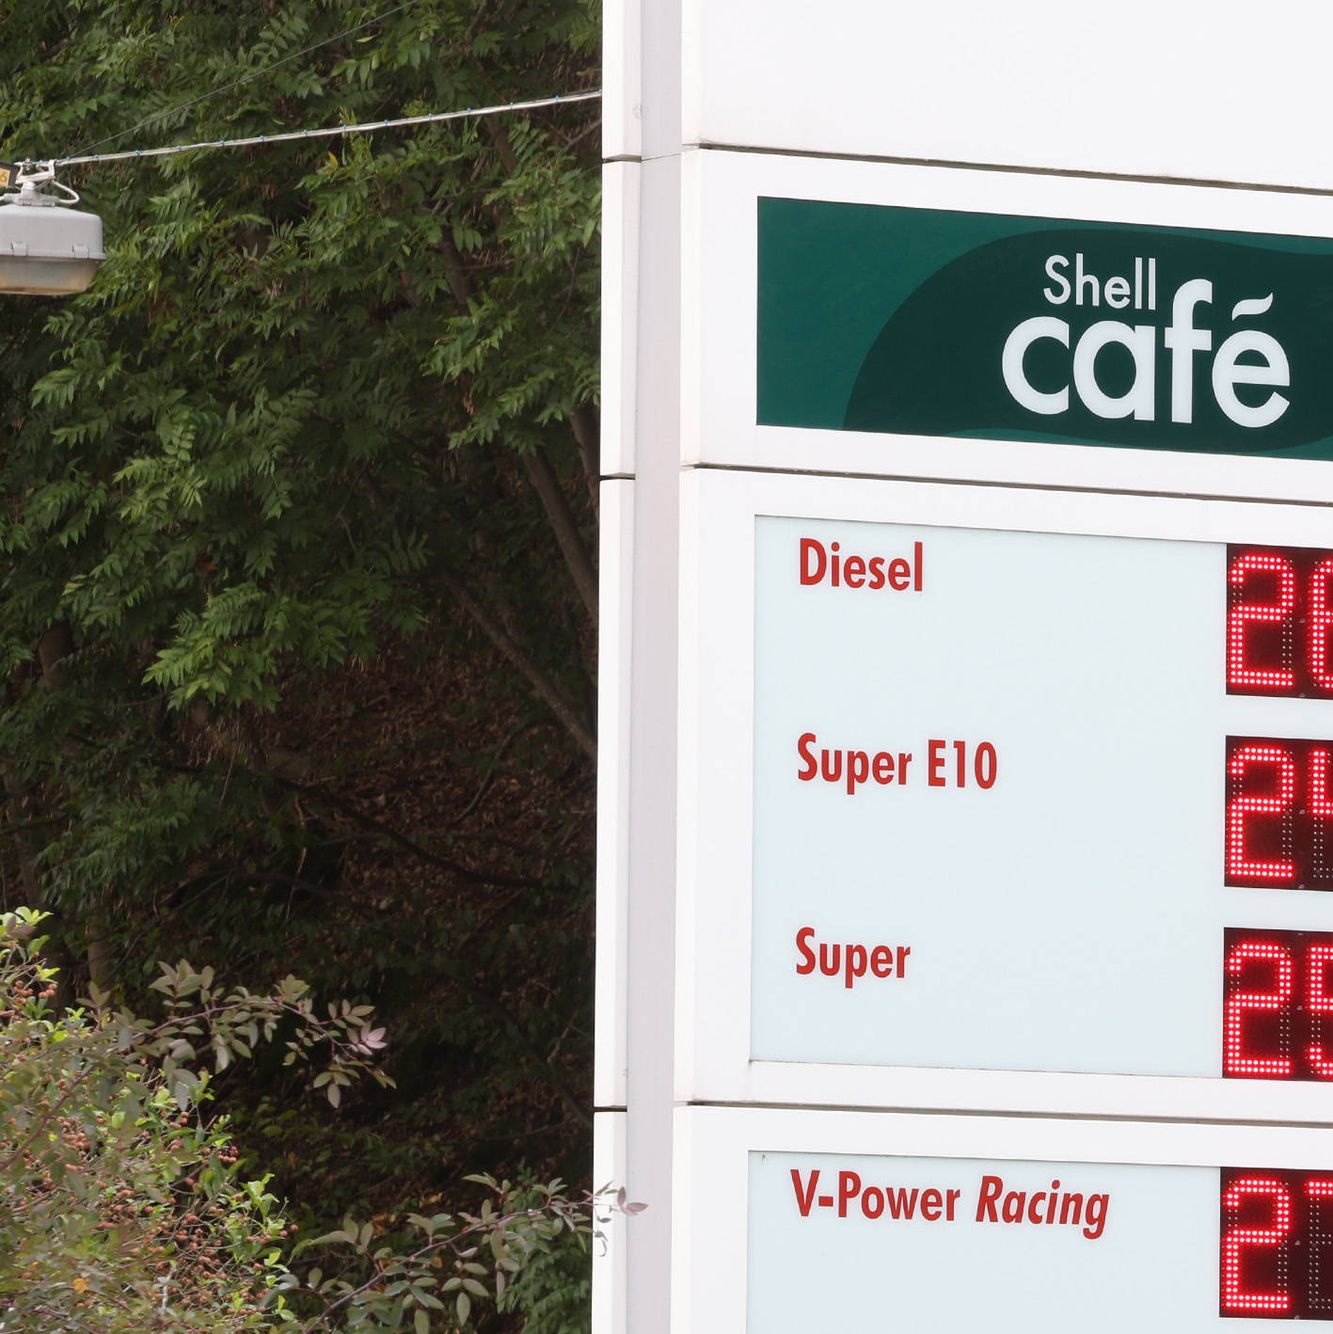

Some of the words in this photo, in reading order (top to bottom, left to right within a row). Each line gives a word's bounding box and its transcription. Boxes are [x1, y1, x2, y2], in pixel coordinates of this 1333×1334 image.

[1044, 254, 1155, 309] Shell
[1003, 278, 1290, 428] café
[800, 538, 922, 591] Diesel
[799, 733, 912, 795] Super
[929, 740, 996, 789] E10
[797, 927, 910, 988] Super
[792, 1169, 960, 1220] V-Power
[977, 1176, 1109, 1239] Racing
